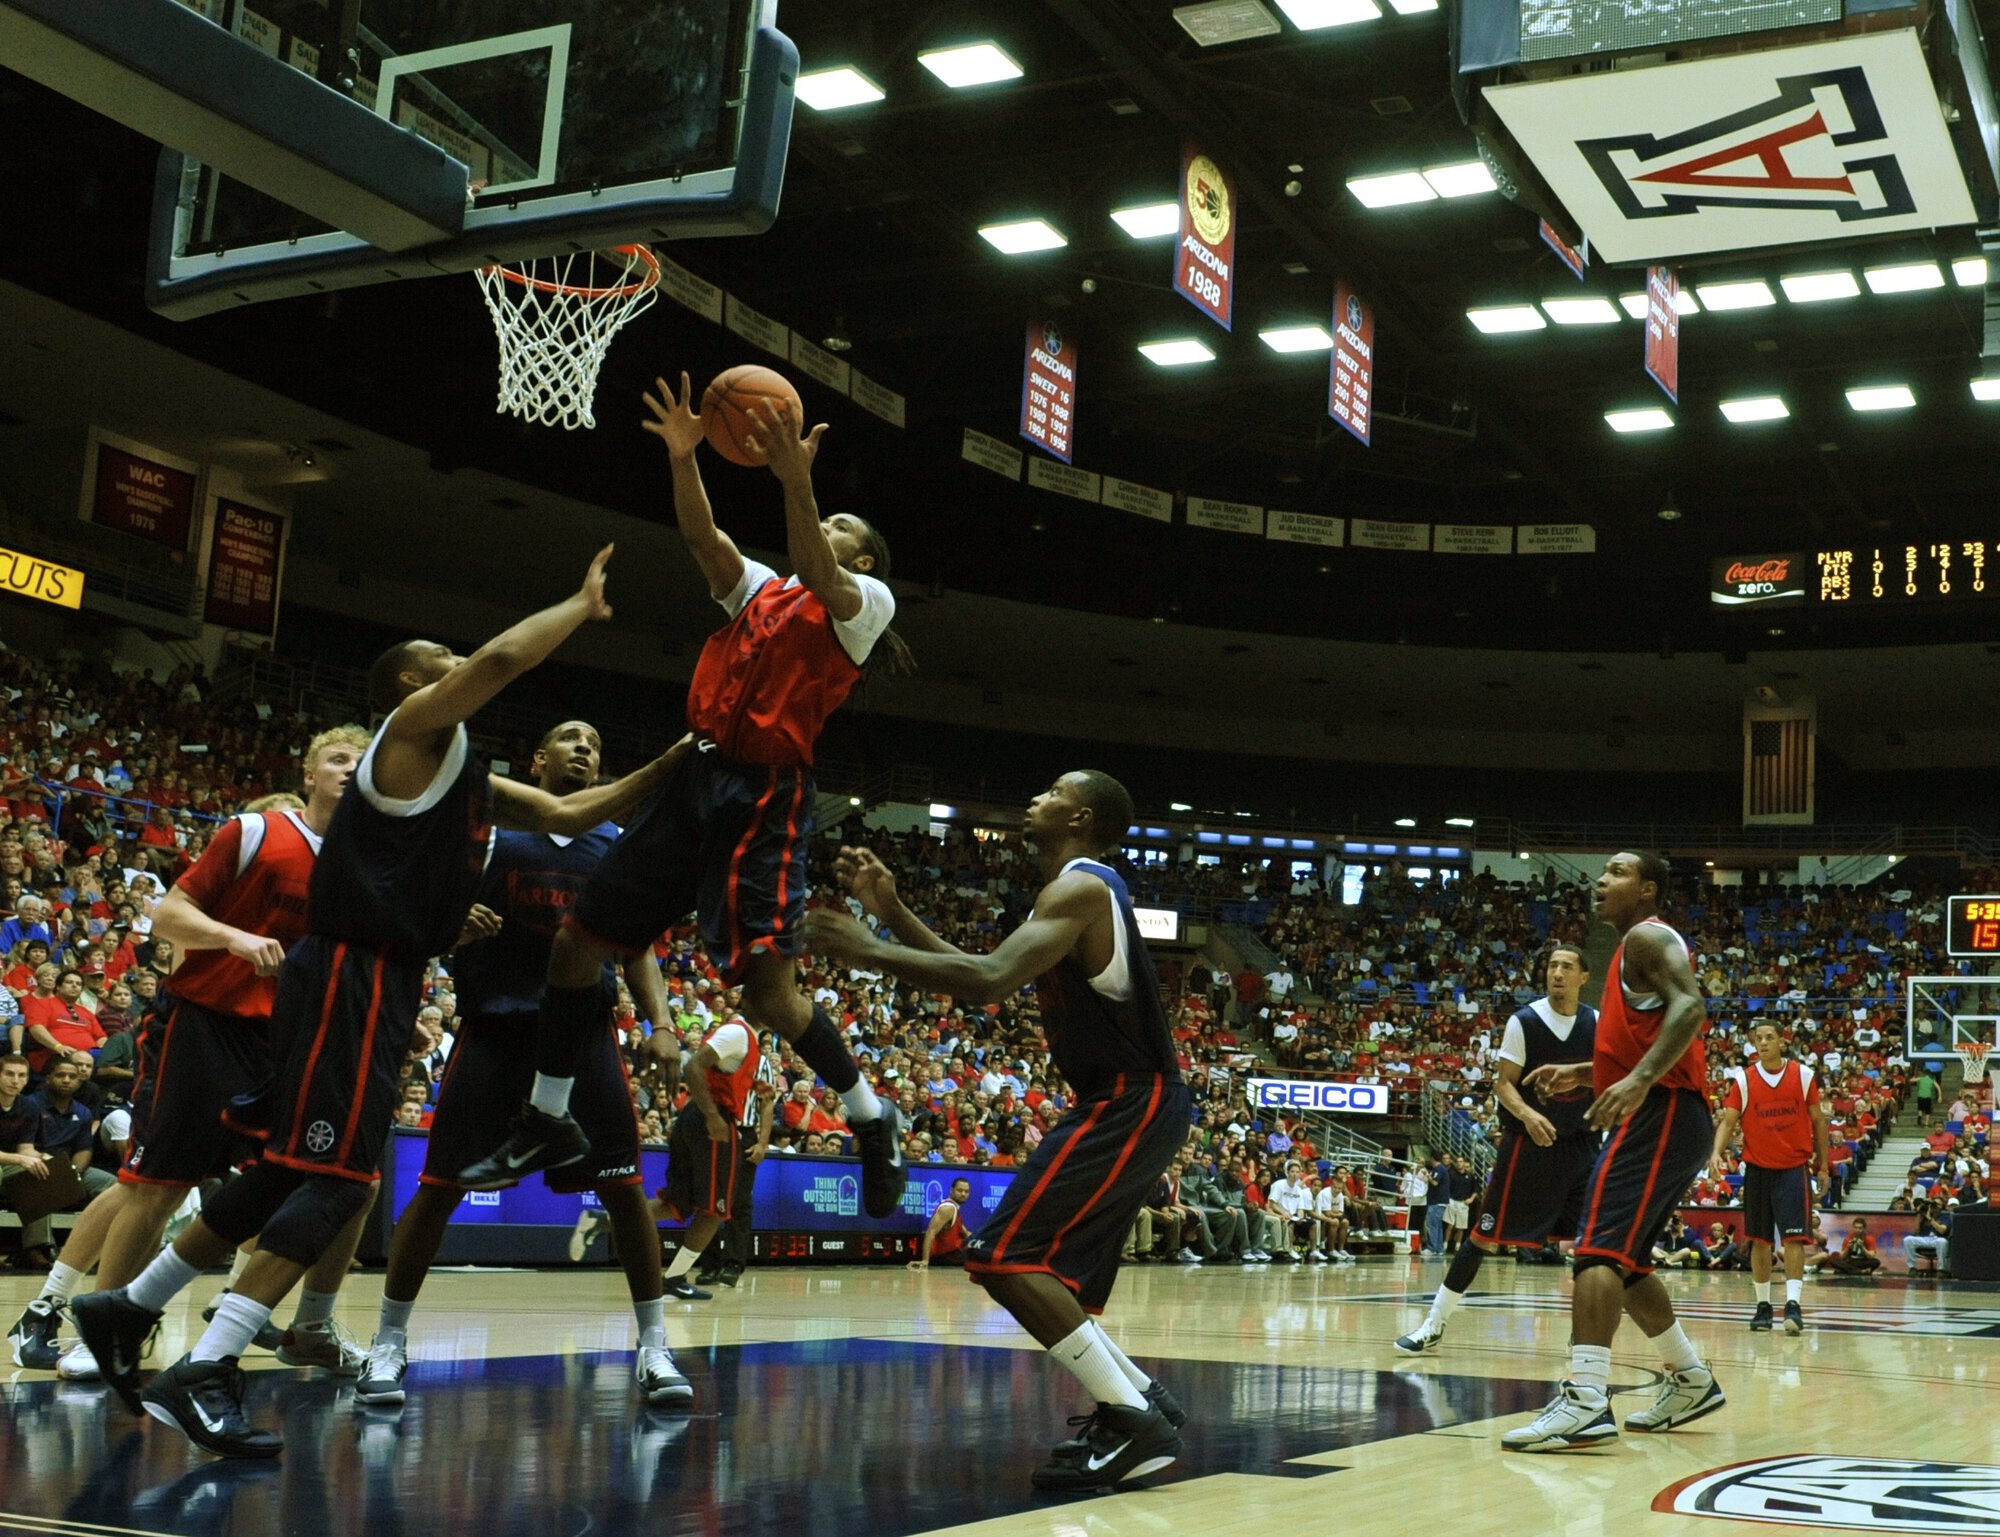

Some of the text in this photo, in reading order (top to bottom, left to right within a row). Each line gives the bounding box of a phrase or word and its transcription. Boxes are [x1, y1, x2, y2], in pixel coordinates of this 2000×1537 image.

[1182, 234, 1229, 281] ARIZONA
[1187, 266, 1221, 307] 1988
[1336, 322, 1371, 361] ARIZONA
[1031, 347, 1073, 382] ARIZONA
[1336, 348, 1369, 384] SWEET 16
[1029, 371, 1070, 404] SWEET 16
[1030, 390, 1069, 421] 1976 1988
[1028, 421, 1046, 440] 1994
[1050, 418, 1068, 436] 1991
[128, 464, 166, 488] WAC
[1203, 501, 1222, 511] SEAN
[129, 513, 156, 531] 1976
[225, 508, 274, 533] Pac-10
[1280, 515, 1295, 523] JUD
[1366, 522, 1385, 531] SEAN
[1451, 527, 1495, 536] STEVE KERR
[1818, 551, 1853, 565] PLYR
[1906, 546, 1917, 559] 2
[1963, 542, 1985, 555] 33
[1725, 560, 1791, 584] Coca-Cola
[1823, 563, 1849, 576] PTS
[1906, 560, 1917, 571] 3
[1939, 557, 1951, 569] 4
[1973, 556, 1985, 567] 2
[1821, 576, 1851, 589] RBS
[1821, 588, 1851, 601] FLS
[1905, 583, 1917, 595] 0
[1939, 581, 1951, 594] 0
[1966, 903, 2000, 920] 5:35
[1972, 923, 1999, 948] 15
[1260, 1083, 1376, 1110] GEICO
[597, 1164, 637, 1178] ATTACK
[813, 1176, 838, 1190] THINK
[904, 1181, 926, 1194] THINK
[990, 1185, 1008, 1196] THIN
[473, 1195, 498, 1203] BELL
[581, 1195, 596, 1206] THE
[803, 1189, 838, 1203] OUTSIDE
[900, 1193, 926, 1206] UTSIDE
[982, 1197, 1003, 1208] OUTS
[814, 1203, 838, 1213] THE BUN
[822, 1241, 845, 1250] GUEST
